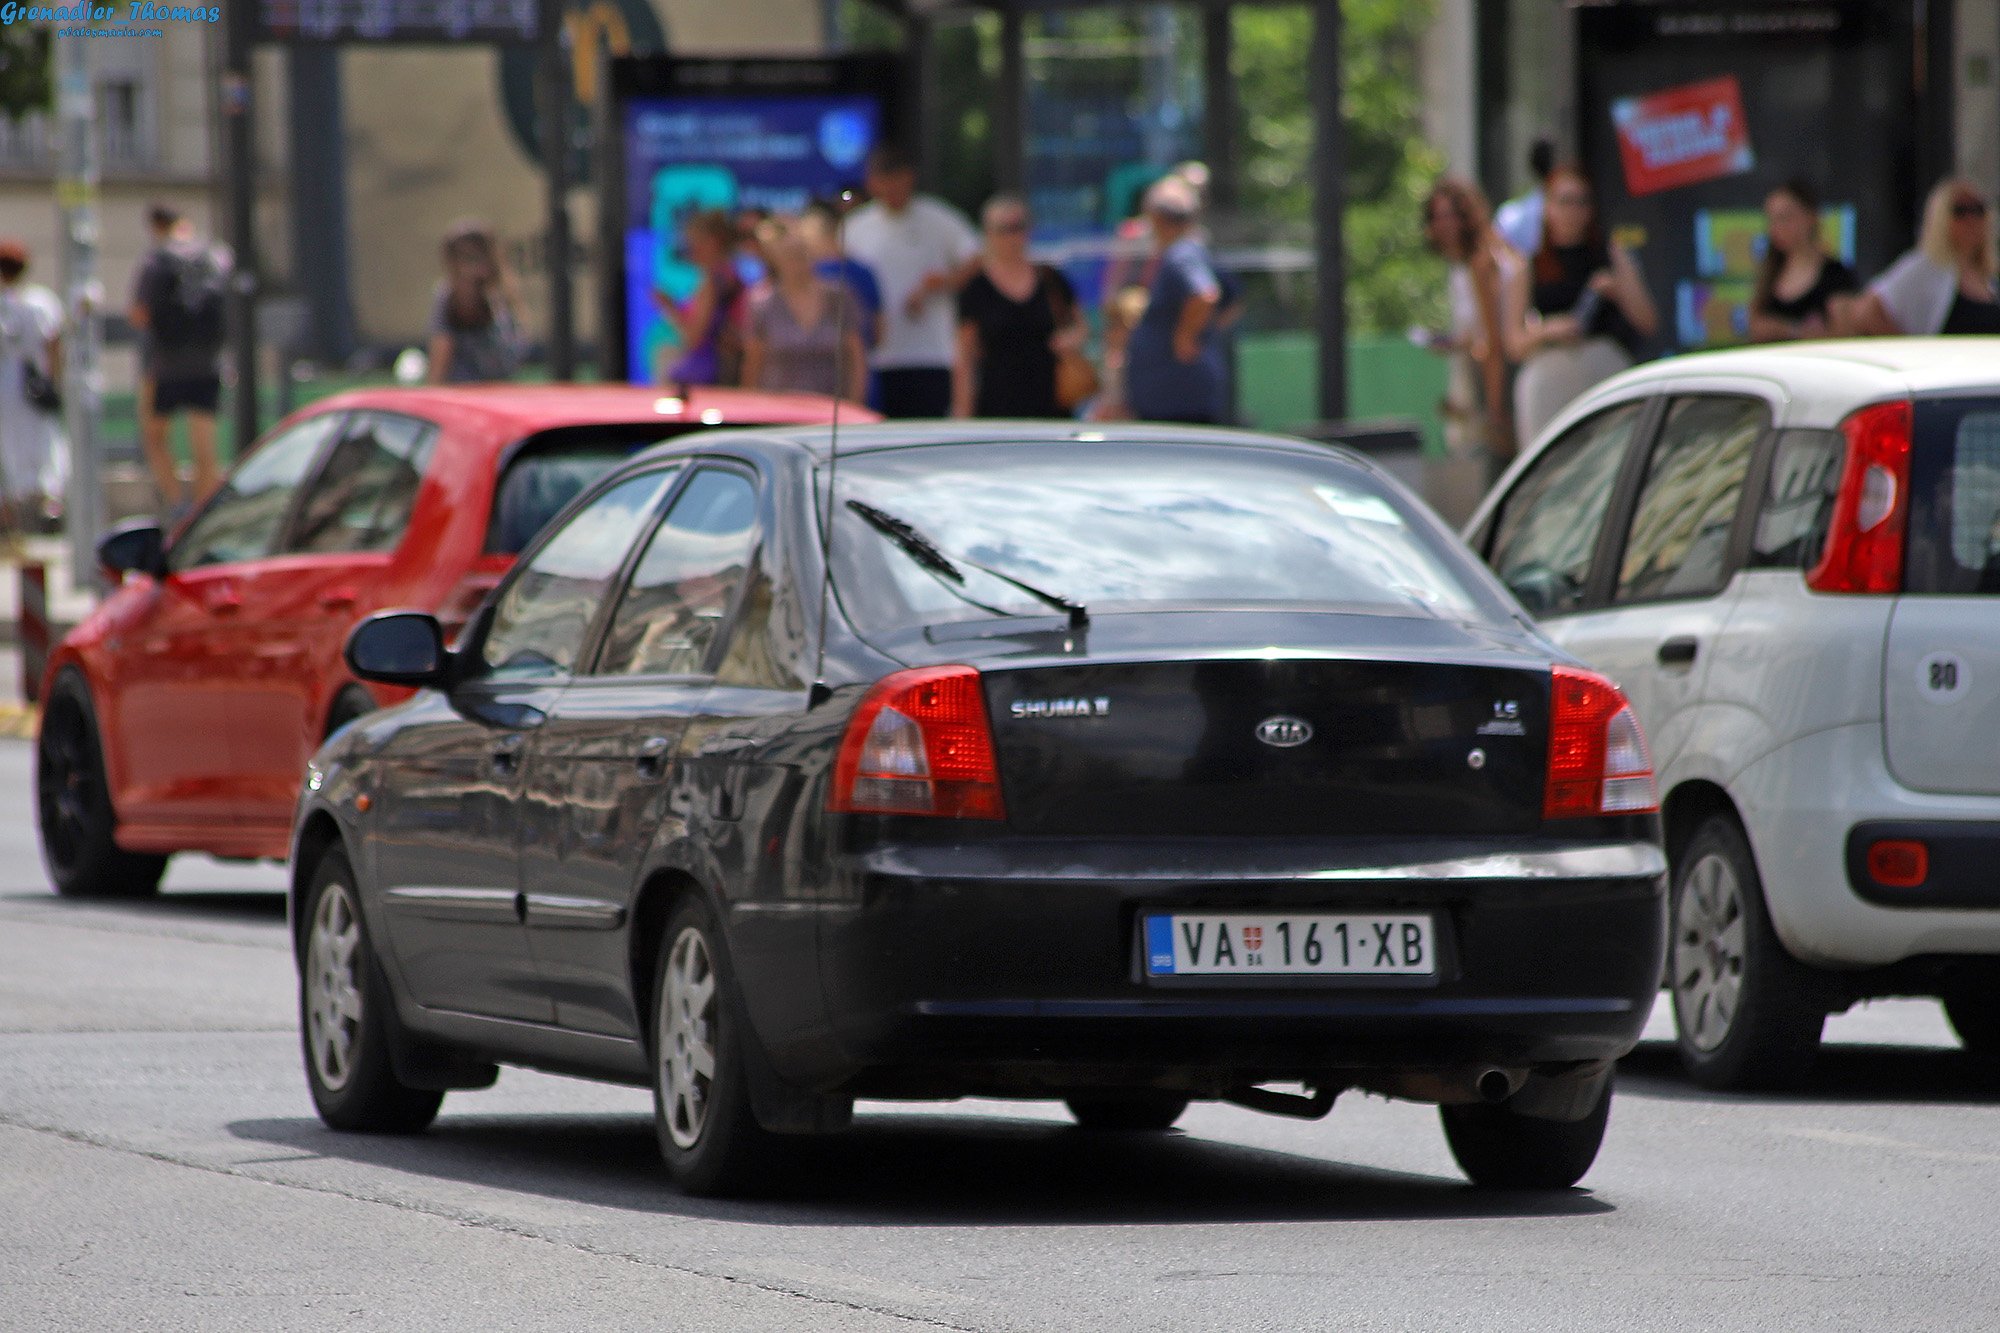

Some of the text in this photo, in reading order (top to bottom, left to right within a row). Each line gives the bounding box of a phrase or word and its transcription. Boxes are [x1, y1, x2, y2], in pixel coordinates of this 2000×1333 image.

[1929, 662, 1957, 689] 80
[1010, 699, 1091, 718] SHUMA
[1264, 723, 1304, 741] KIA
[1181, 921, 1237, 966] VA
